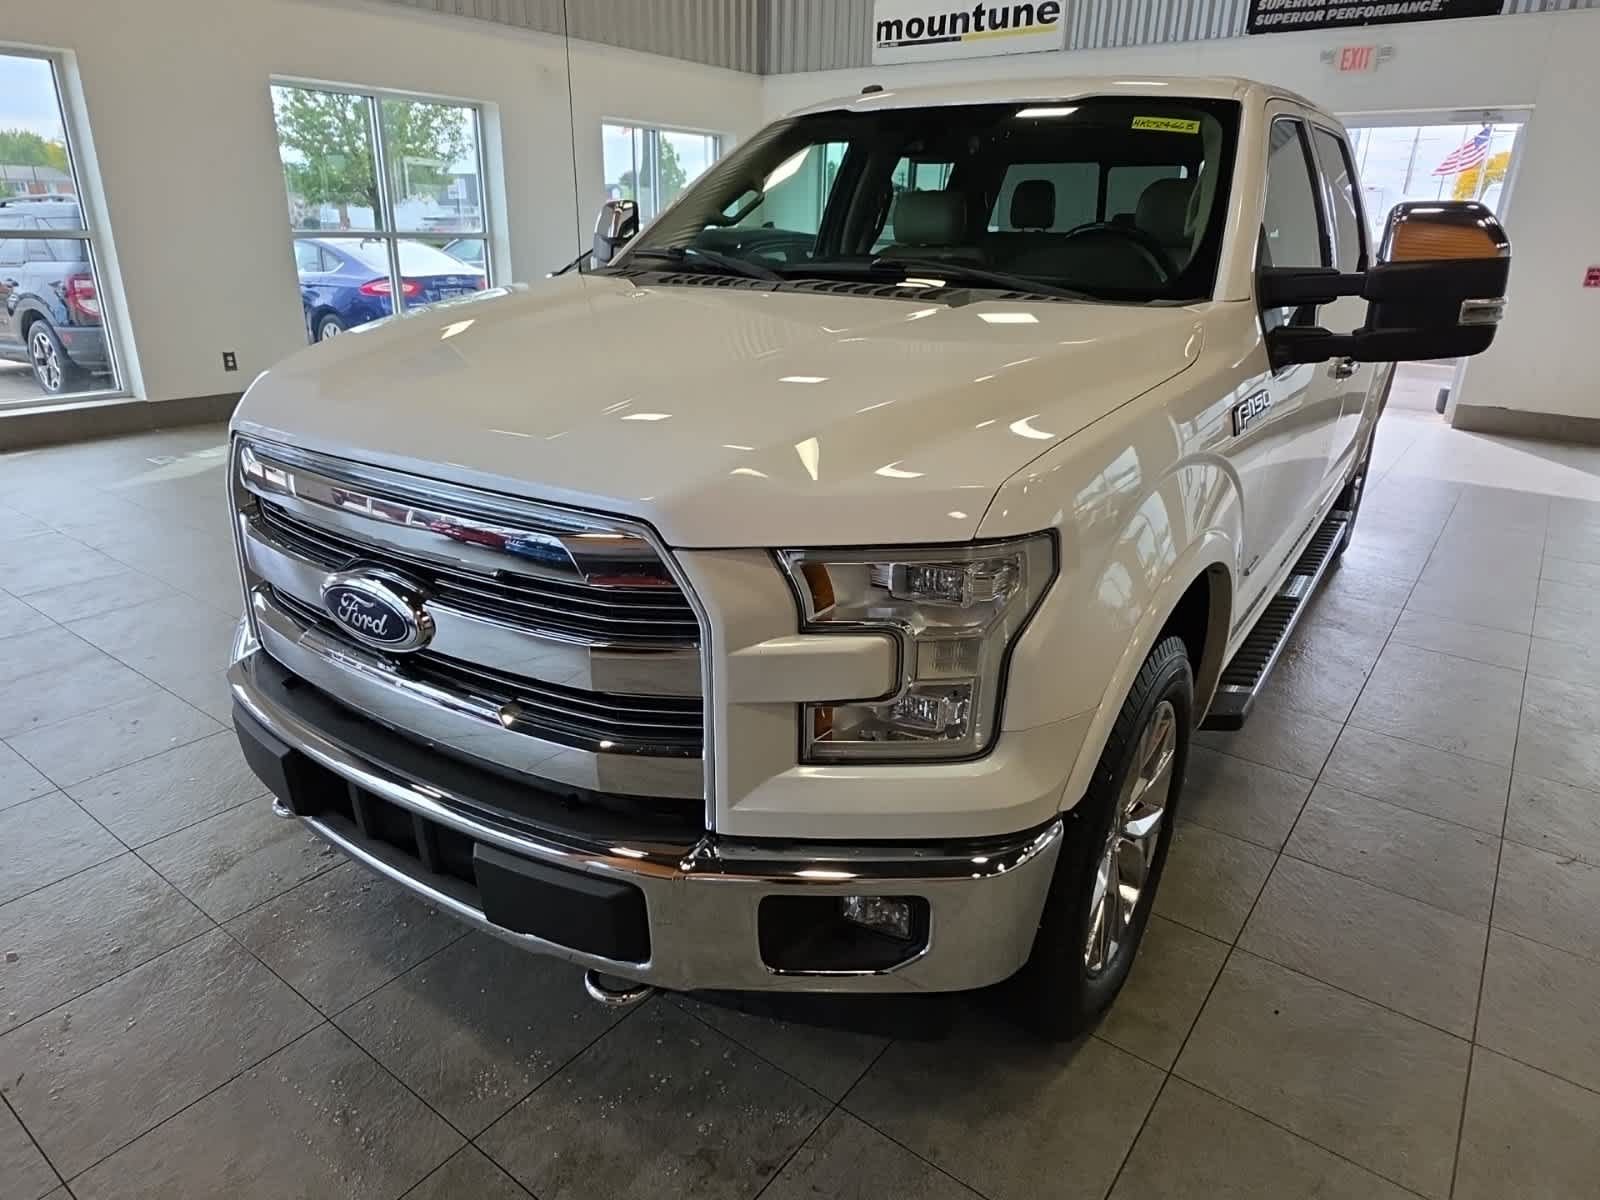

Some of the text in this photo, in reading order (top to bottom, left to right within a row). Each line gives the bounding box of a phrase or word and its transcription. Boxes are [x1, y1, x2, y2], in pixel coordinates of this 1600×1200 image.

[876, 1, 1060, 41] mountune
[1255, 0, 1443, 26] SUPERIOR PERFORMANCE.
[1341, 47, 1373, 71] EXIT
[337, 592, 388, 636] Ford
